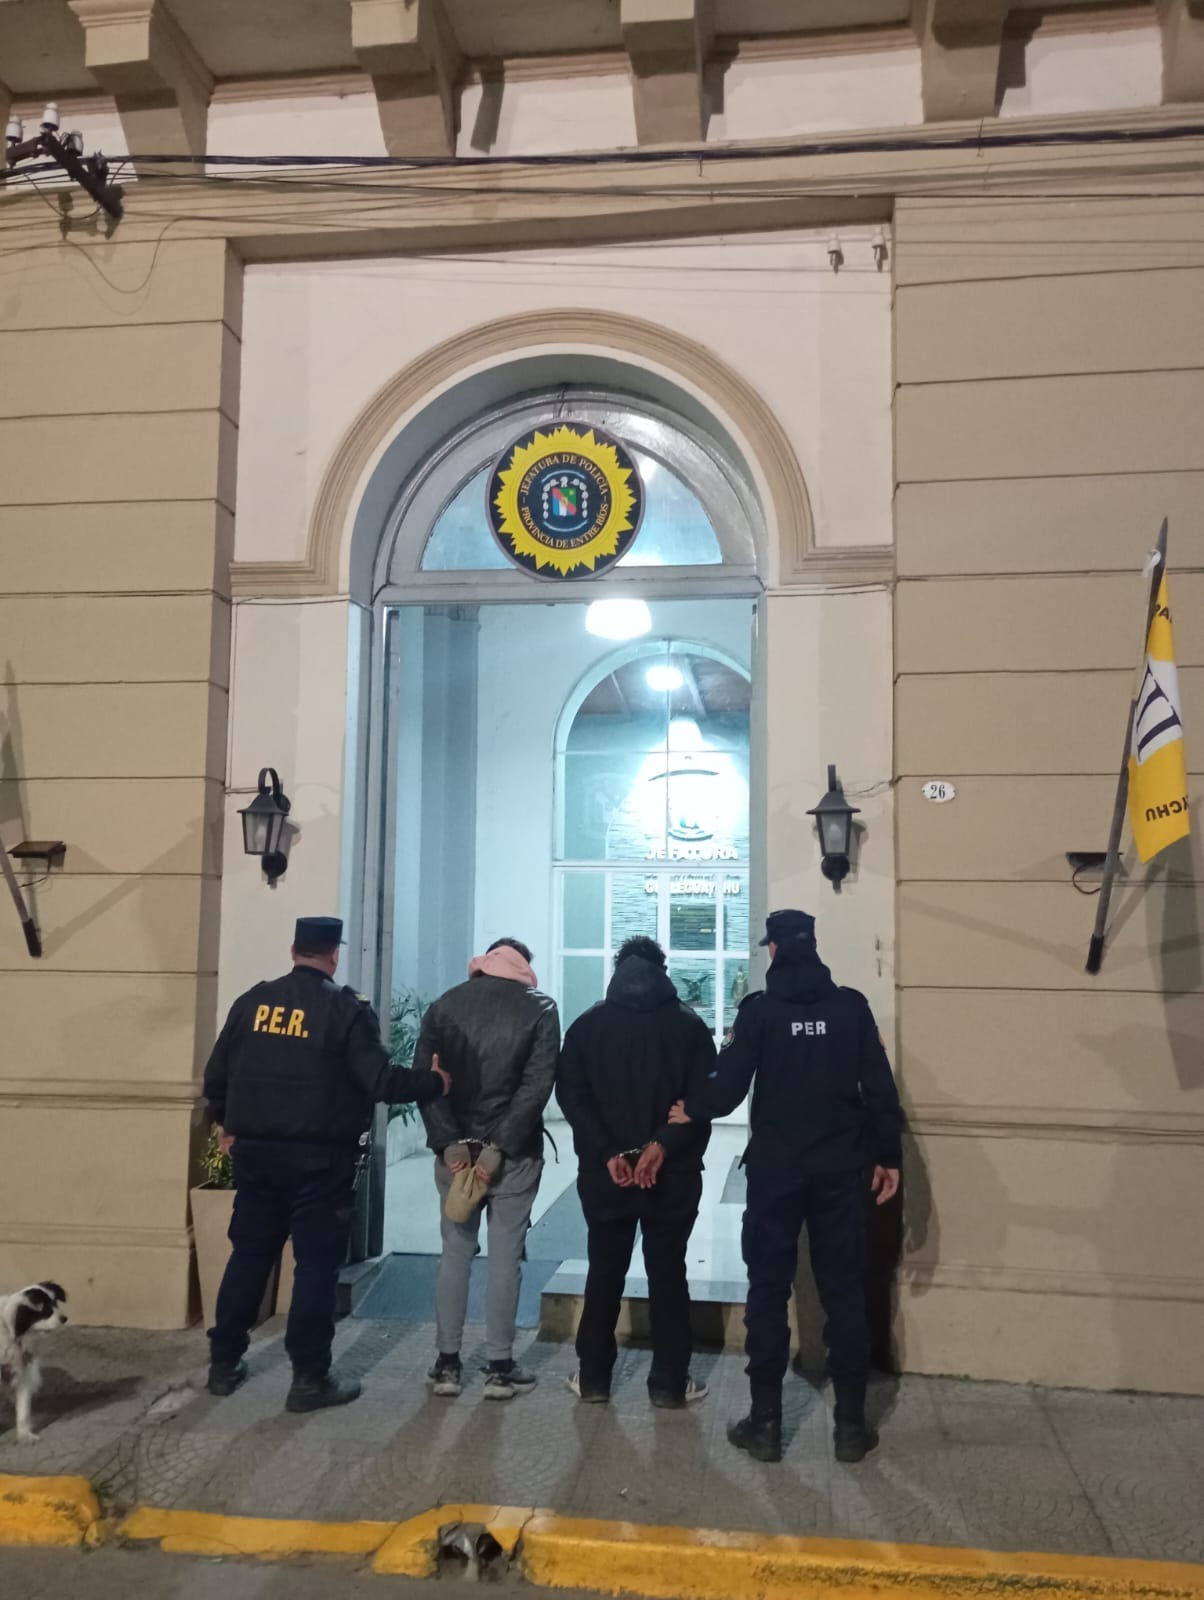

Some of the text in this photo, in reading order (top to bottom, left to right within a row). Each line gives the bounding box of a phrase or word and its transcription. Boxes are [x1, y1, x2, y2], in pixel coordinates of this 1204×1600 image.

[521, 455, 559, 495] JEFATURA
[562, 454, 577, 464] DE
[521, 506, 554, 547] PROVINCIA
[556, 539, 569, 549] DE
[570, 525, 600, 548] ENTRE
[930, 784, 946, 800] 26
[253, 1004, 309, 1038] P.E.R.
[791, 1020, 827, 1037] PER
